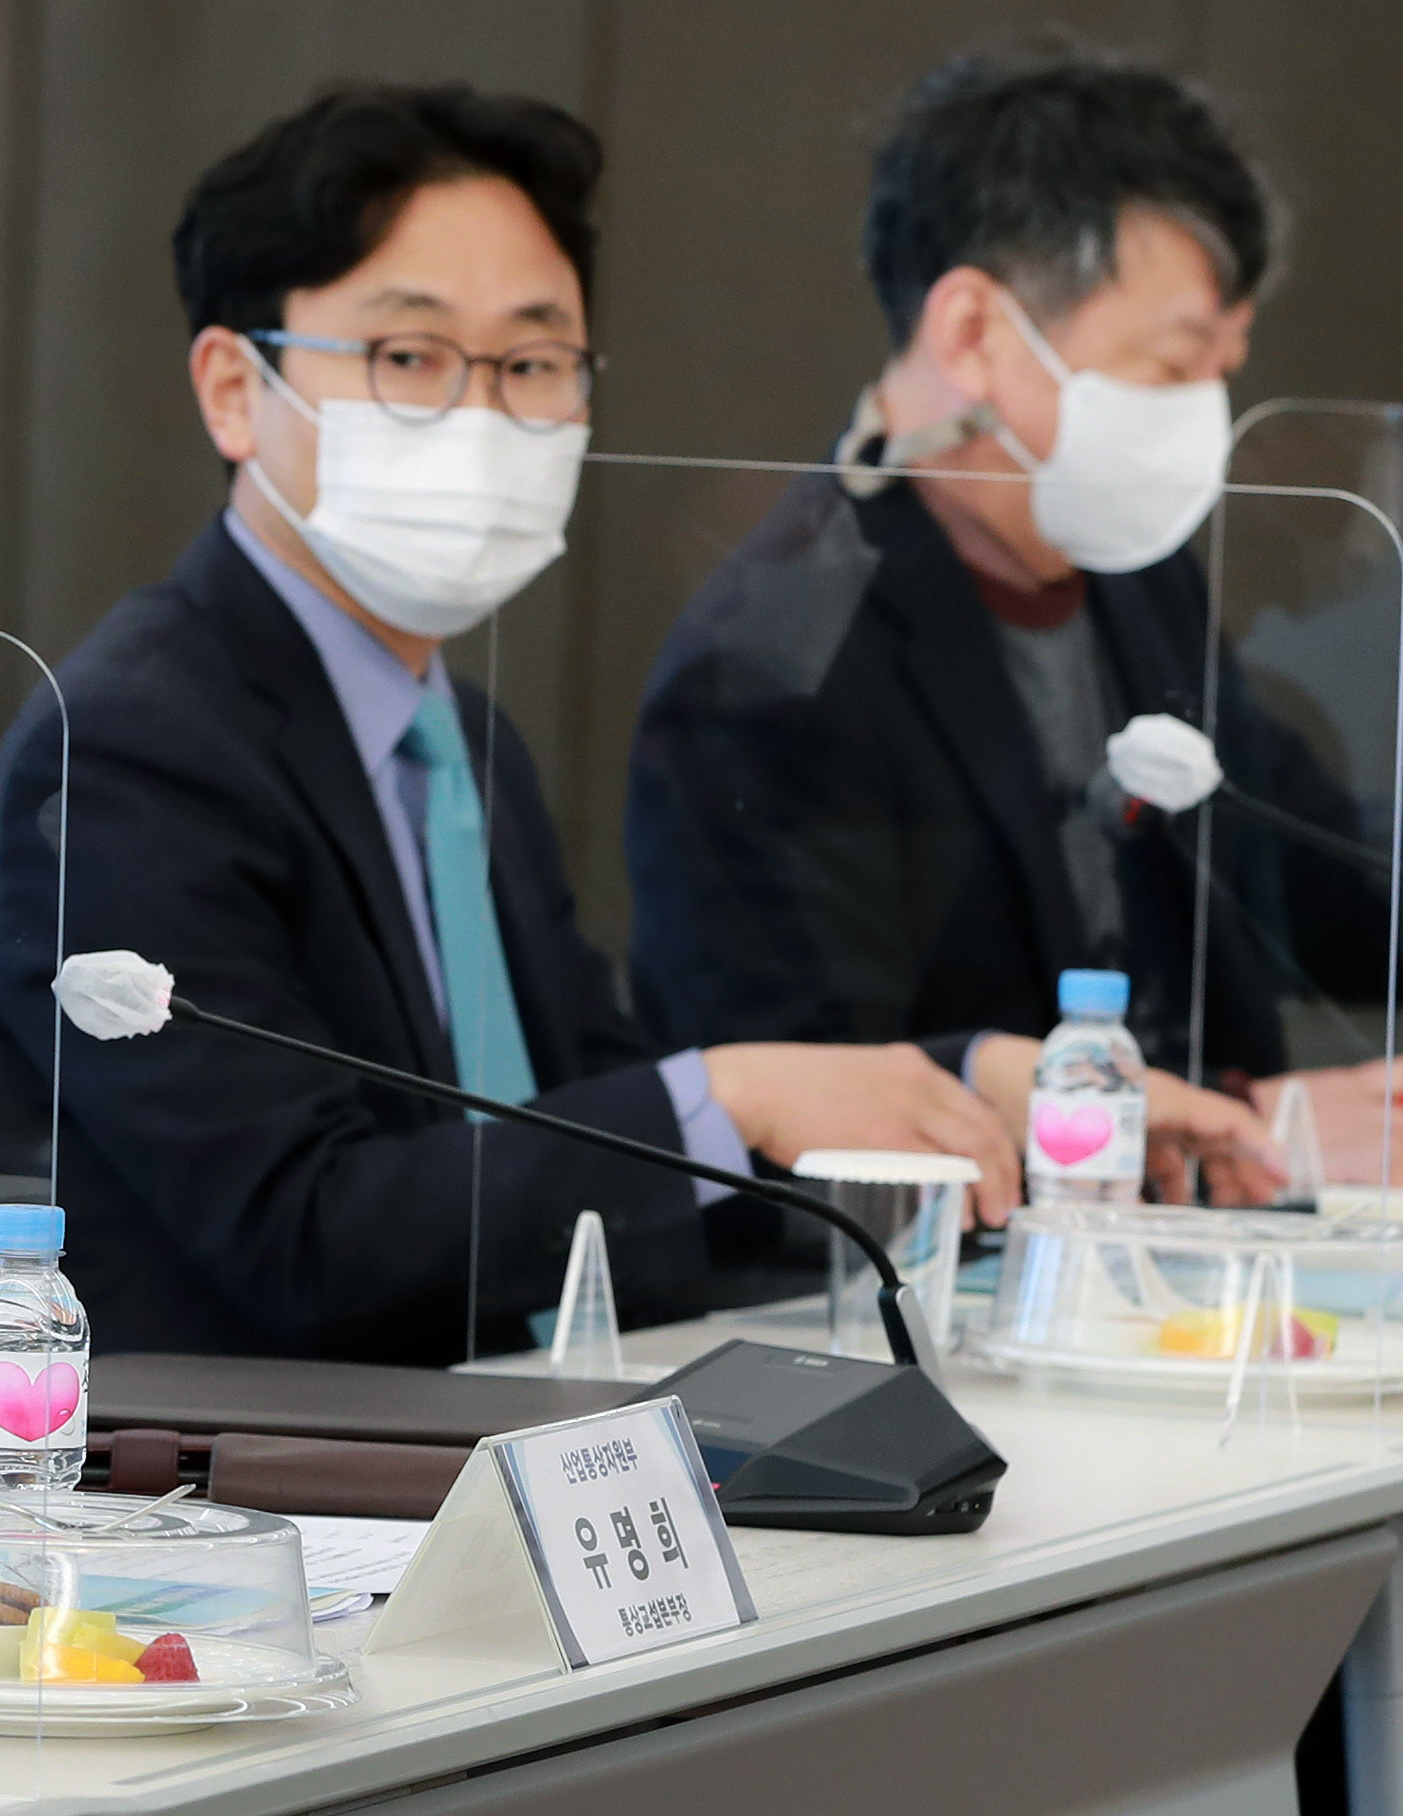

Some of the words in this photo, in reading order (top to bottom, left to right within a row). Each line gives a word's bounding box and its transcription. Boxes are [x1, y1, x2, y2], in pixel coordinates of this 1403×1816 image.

[560, 1438, 637, 1484] 산업통상자원부
[574, 1497, 689, 1590] 유명희
[618, 1592, 692, 1637] 통상교섭본부장
